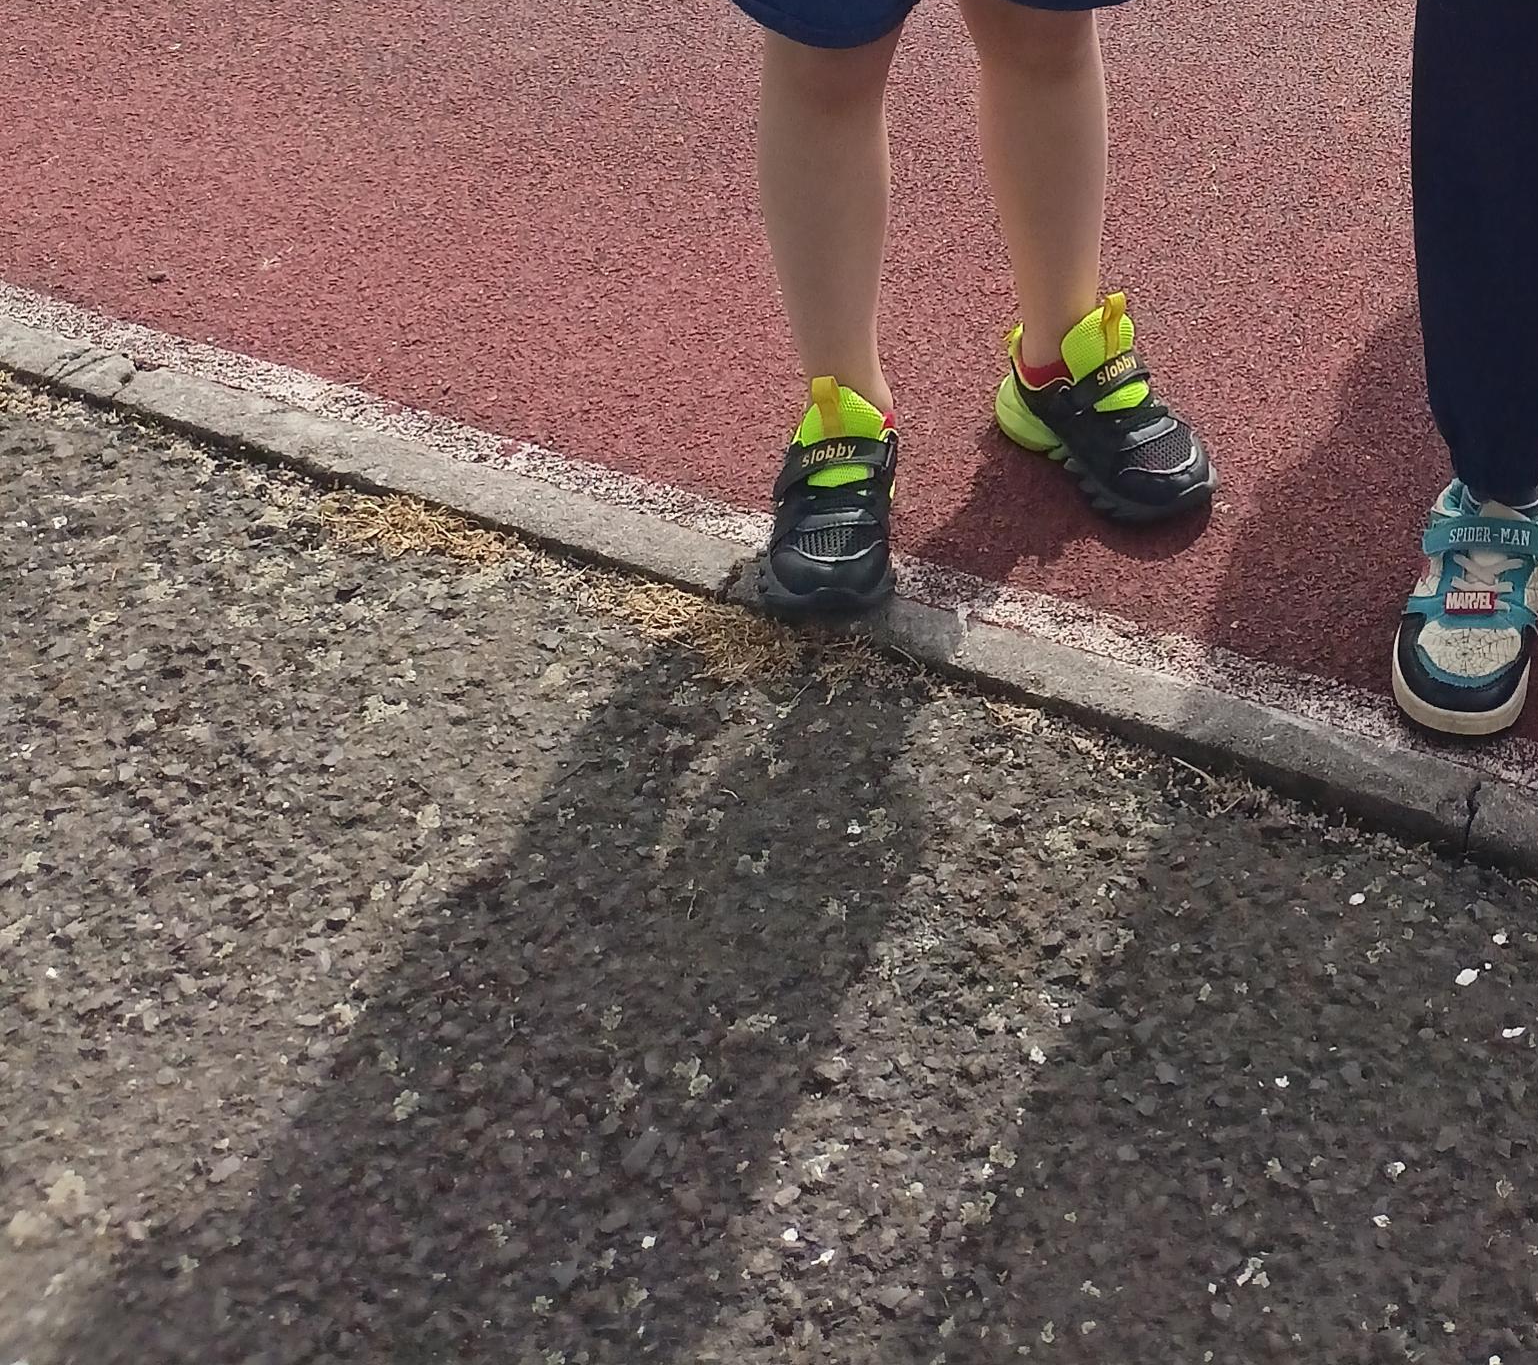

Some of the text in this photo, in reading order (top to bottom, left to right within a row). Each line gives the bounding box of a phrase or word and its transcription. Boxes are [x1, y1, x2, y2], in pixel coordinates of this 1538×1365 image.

[1096, 355, 1138, 386] slobby
[801, 442, 857, 468] slobby
[1448, 526, 1531, 547] SPIDER-MAN
[1446, 592, 1493, 610] MARVEL
